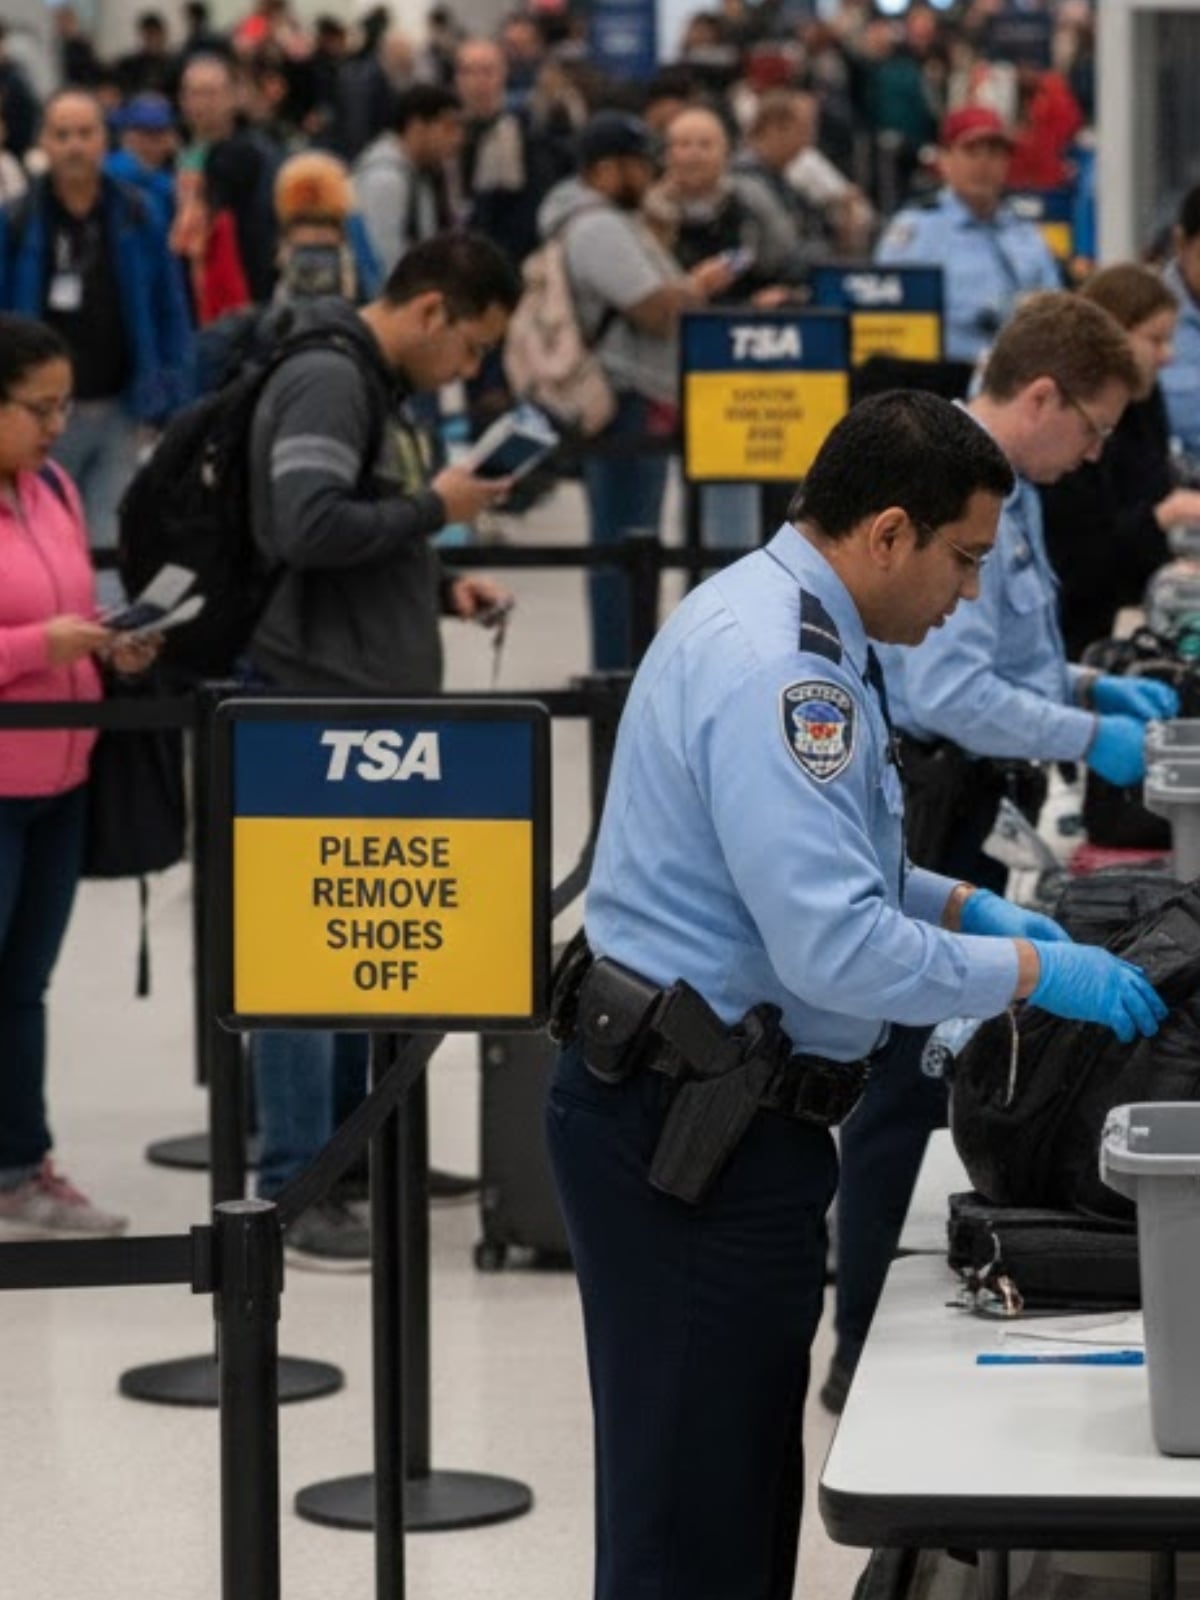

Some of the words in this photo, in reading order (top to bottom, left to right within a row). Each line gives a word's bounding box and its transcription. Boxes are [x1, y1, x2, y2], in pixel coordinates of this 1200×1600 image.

[320, 730, 441, 781] TSA
[319, 836, 450, 868] PLEASE
[312, 877, 458, 908] REMOVE
[326, 919, 443, 950] SHOES
[353, 960, 418, 991] OFF
